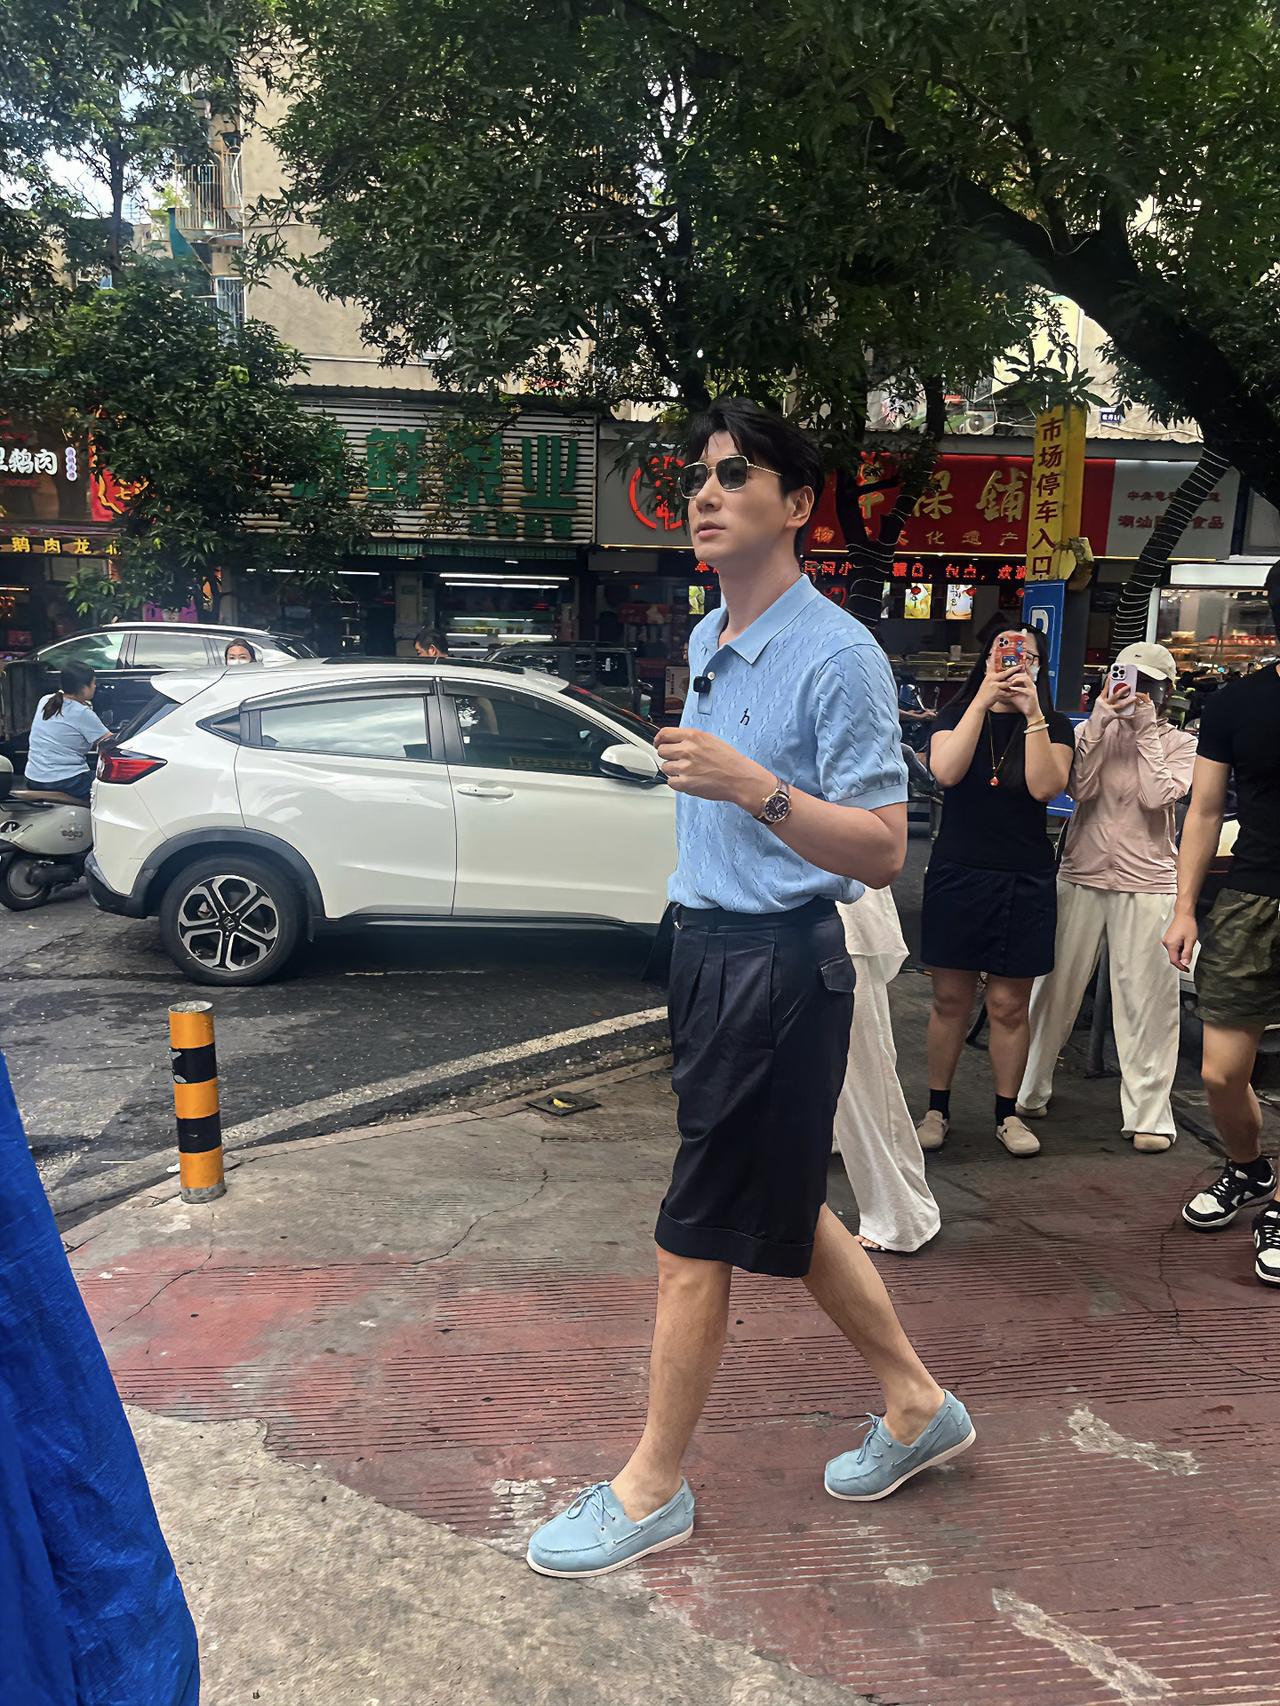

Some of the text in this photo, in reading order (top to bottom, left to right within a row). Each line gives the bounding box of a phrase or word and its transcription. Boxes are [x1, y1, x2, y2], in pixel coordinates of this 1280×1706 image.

[1032, 417, 1064, 575] 市场停车入口
[1117, 515, 1225, 529] 潮汕食品
